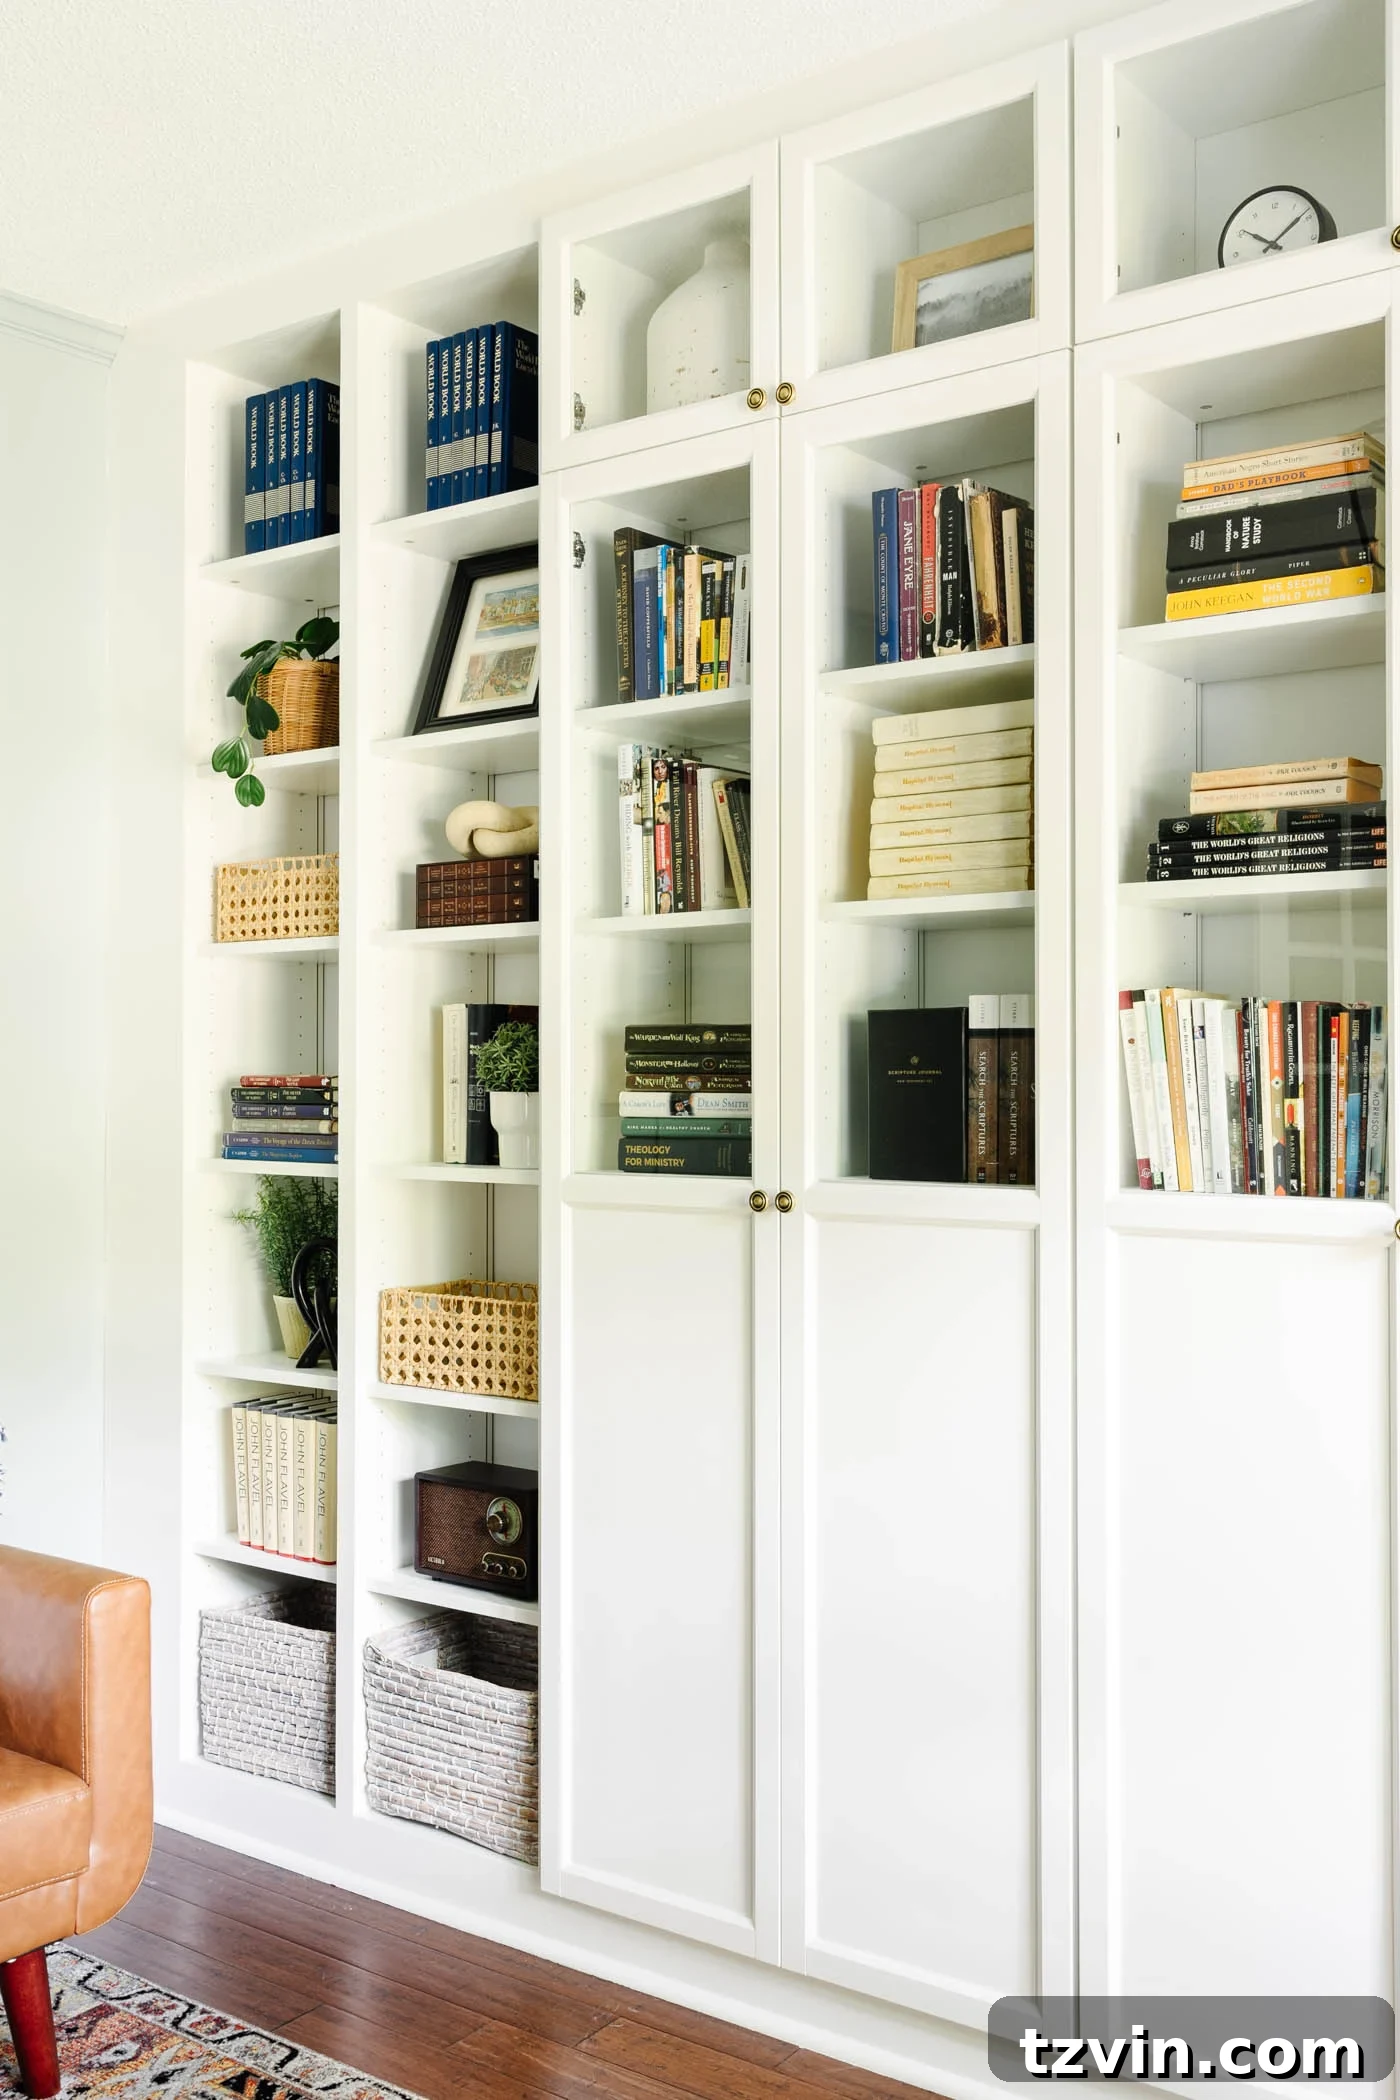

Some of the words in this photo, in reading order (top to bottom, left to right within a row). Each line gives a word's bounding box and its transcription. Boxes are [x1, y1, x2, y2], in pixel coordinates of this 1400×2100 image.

[1213, 481, 1245, 493] DAD'S
[1248, 471, 1307, 487] PLAYBOOK
[903, 521, 913, 555] JANE
[1242, 516, 1251, 549] NATURE
[1253, 518, 1262, 544] STUDY
[880, 576, 886, 584] OF
[904, 557, 913, 590] EYRE
[923, 557, 934, 609] FAHRENHEIT
[1188, 572, 1227, 583] PECULIAR
[1230, 568, 1257, 577] GLORY
[1263, 582, 1282, 593] THE
[1287, 576, 1332, 589] SECOND
[616, 589, 622, 601] OF
[1172, 601, 1201, 613] JOHN
[1206, 592, 1254, 607] KEEGAN
[1262, 592, 1301, 603] WORLD
[1306, 588, 1330, 599] WAR
[623, 607, 628, 619] TO
[1191, 841, 1208, 850] THE
[1210, 837, 1246, 848] WORLD'S
[1248, 836, 1276, 846] GREAT
[1277, 833, 1325, 843] RELIGIONS
[1371, 828, 1385, 836] LIFE
[1163, 858, 1172, 866] 2
[1194, 854, 1212, 863] THE
[1213, 851, 1249, 862] WORLD'S
[1251, 849, 1279, 859] GREAT
[1281, 846, 1328, 856] RELIGIONS
[1192, 868, 1209, 876] THE
[1210, 865, 1248, 875] WORLD'S
[1249, 863, 1278, 873] GREAT
[1280, 862, 1326, 871] RELIGIONS
[675, 858, 683, 894] Reynolds
[979, 1051, 987, 1086] SEARCH
[1010, 1051, 1018, 1086] SEARCH
[1351, 1051, 1359, 1078] Balance
[697, 1098, 720, 1108] DEAN
[722, 1097, 749, 1108] SMITH
[1371, 1091, 1380, 1139] MORRISON
[625, 1145, 671, 1154] THEOLOGY
[625, 1157, 642, 1166] FOR
[644, 1158, 685, 1166] MINISTRY
[235, 1416, 245, 1450] JOHN
[250, 1418, 260, 1454] JOHN
[264, 1422, 273, 1458] JOHN
[280, 1425, 288, 1460] JOHN
[297, 1428, 305, 1464] JOHN
[318, 1431, 327, 1467] JOHN
[237, 1455, 247, 1502] FLAVEL
[251, 1459, 260, 1506] FLAVEL
[265, 1462, 273, 1511] FLAVEL
[280, 1465, 288, 1512] FLAVEL
[297, 1468, 305, 1518] FLAVEL
